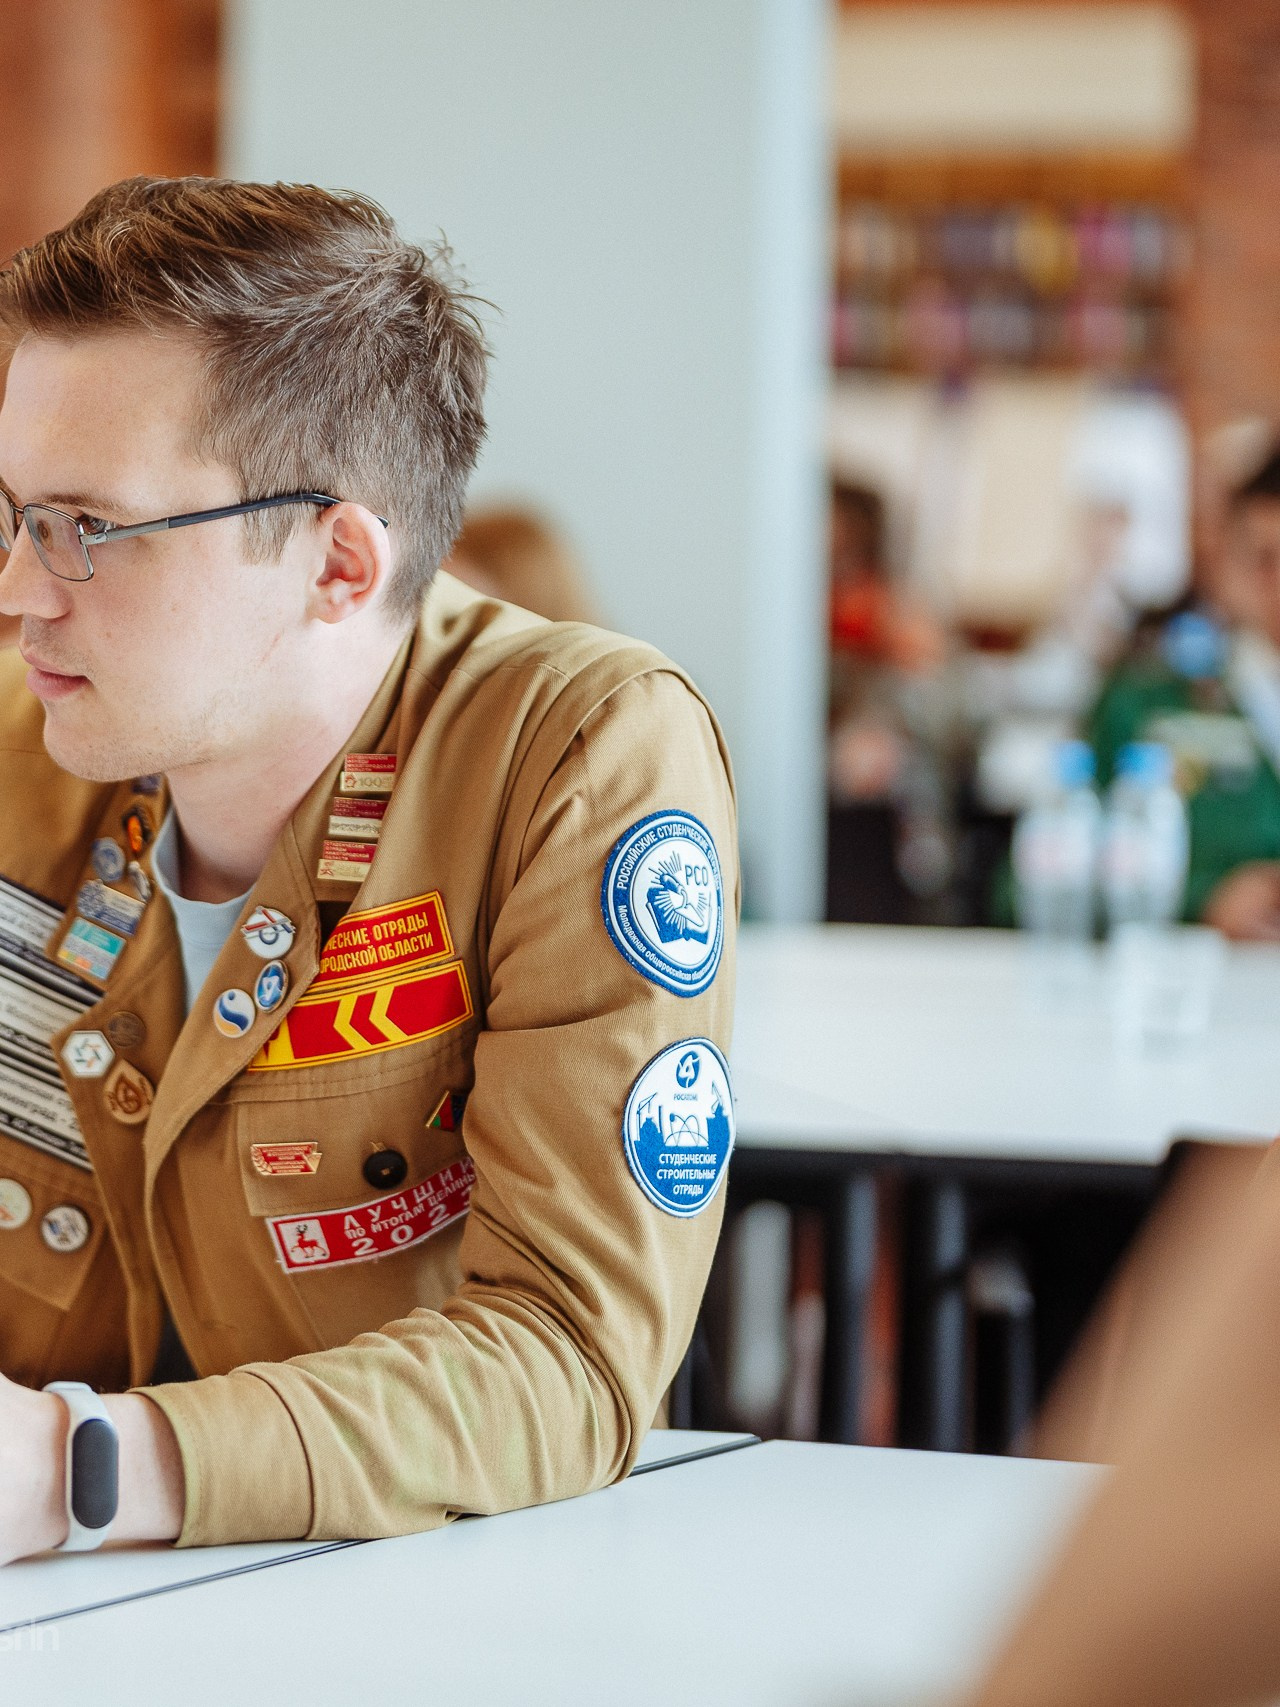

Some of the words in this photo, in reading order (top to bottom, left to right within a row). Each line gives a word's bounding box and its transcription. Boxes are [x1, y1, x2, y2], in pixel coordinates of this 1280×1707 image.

[616, 830, 658, 890] РОССИЙСКИЕ
[656, 823, 709, 852] СТУДЕНЧЕСКИЕ
[685, 865, 709, 887] РСО
[372, 912, 429, 941] ОТРЯДЫ
[377, 932, 434, 962] ОБЛАСТИ
[658, 1153, 717, 1165] СТУДЕНЧЕСКИЕ
[656, 1168, 716, 1180] СТРОИТЕЛЬНЫЕ
[673, 1184, 704, 1197] ОТРЯДЫ
[344, 1227, 366, 1240] ПО
[371, 1202, 426, 1234] ИТОГАМ
